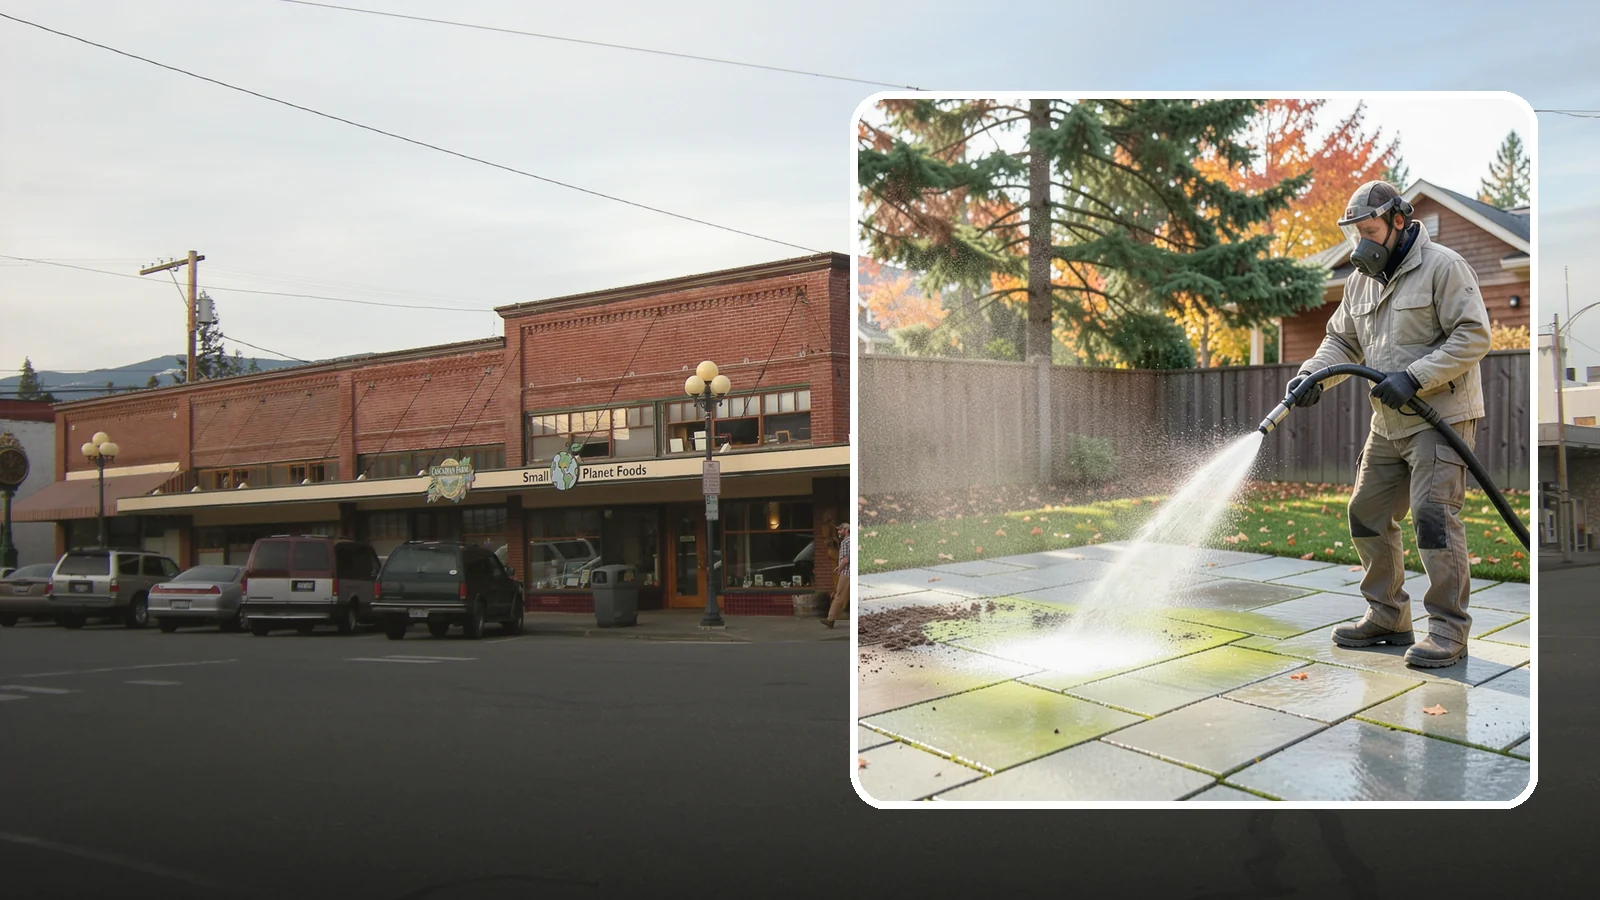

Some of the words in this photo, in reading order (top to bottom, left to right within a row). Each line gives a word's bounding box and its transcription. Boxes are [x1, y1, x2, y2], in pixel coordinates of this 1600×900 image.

[523, 471, 549, 483] Small
[582, 467, 614, 479] Planet
[616, 464, 647, 477] Foods
